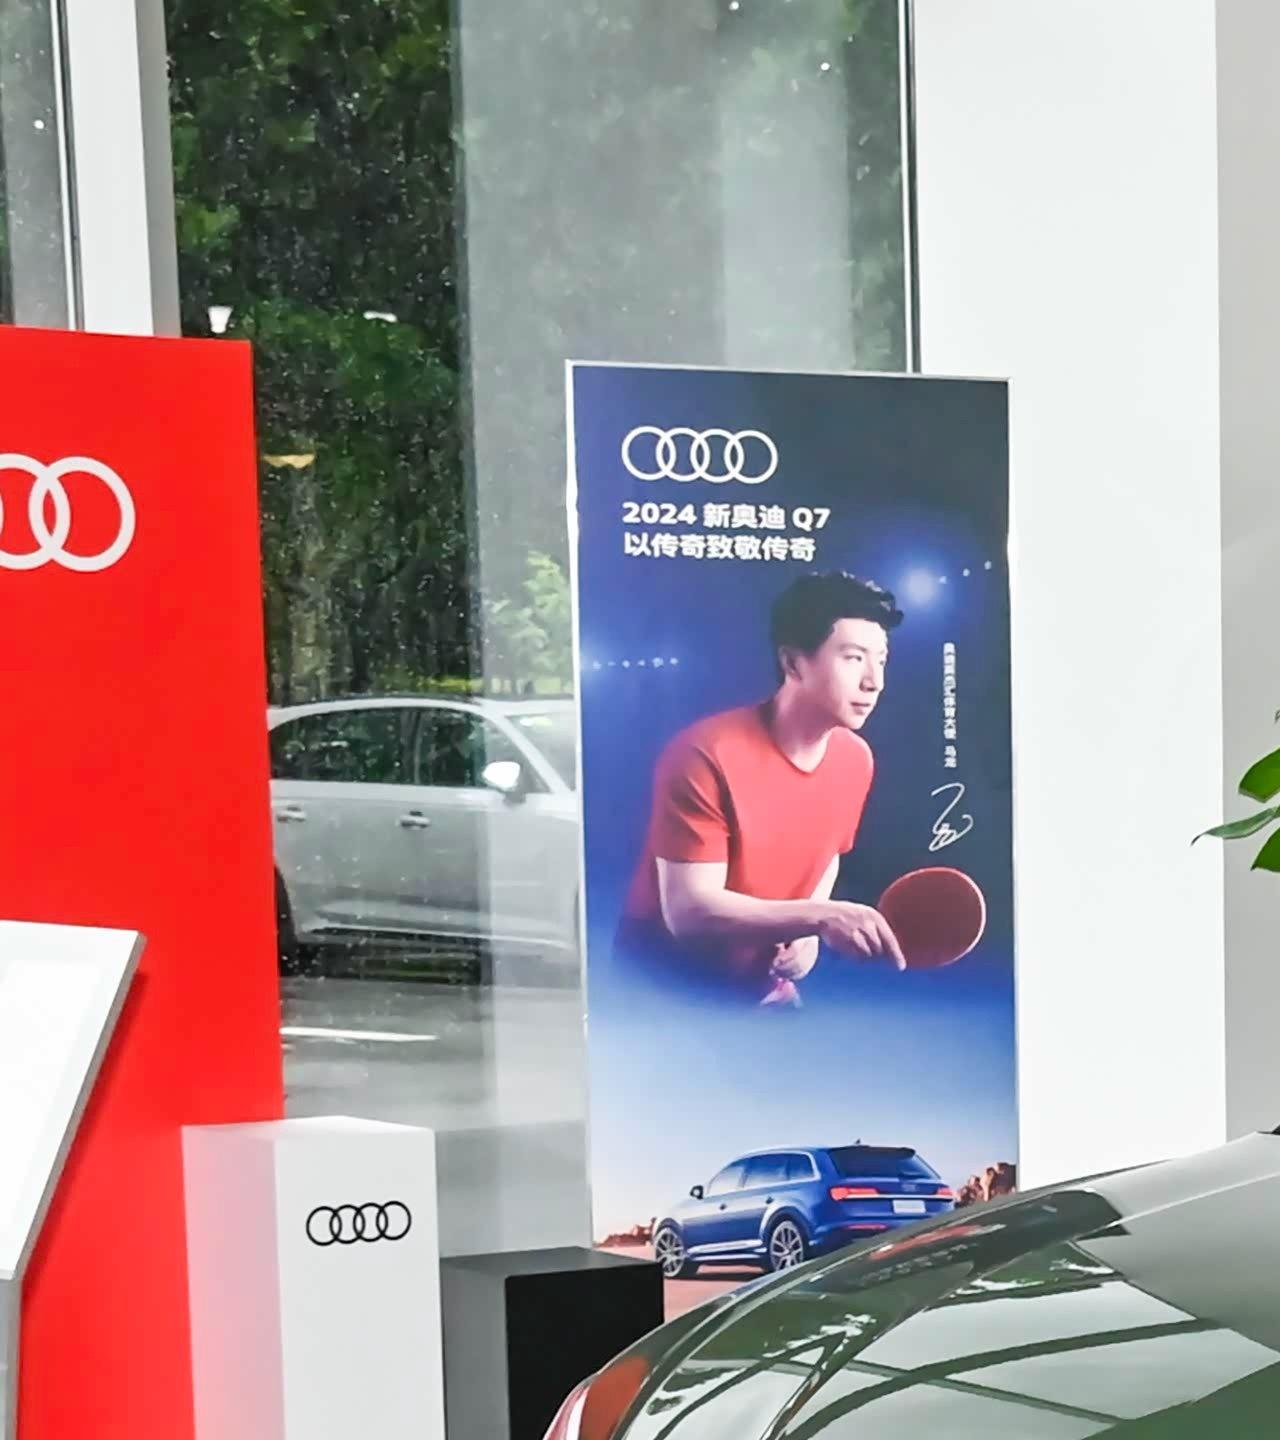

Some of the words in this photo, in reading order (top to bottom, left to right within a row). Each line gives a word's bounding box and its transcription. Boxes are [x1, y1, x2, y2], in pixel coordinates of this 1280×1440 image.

[622, 501, 697, 525] 2024
[703, 502, 786, 529] 新奥迪
[792, 507, 831, 531] Q7
[623, 531, 816, 562] 以传奇致敬传奇
